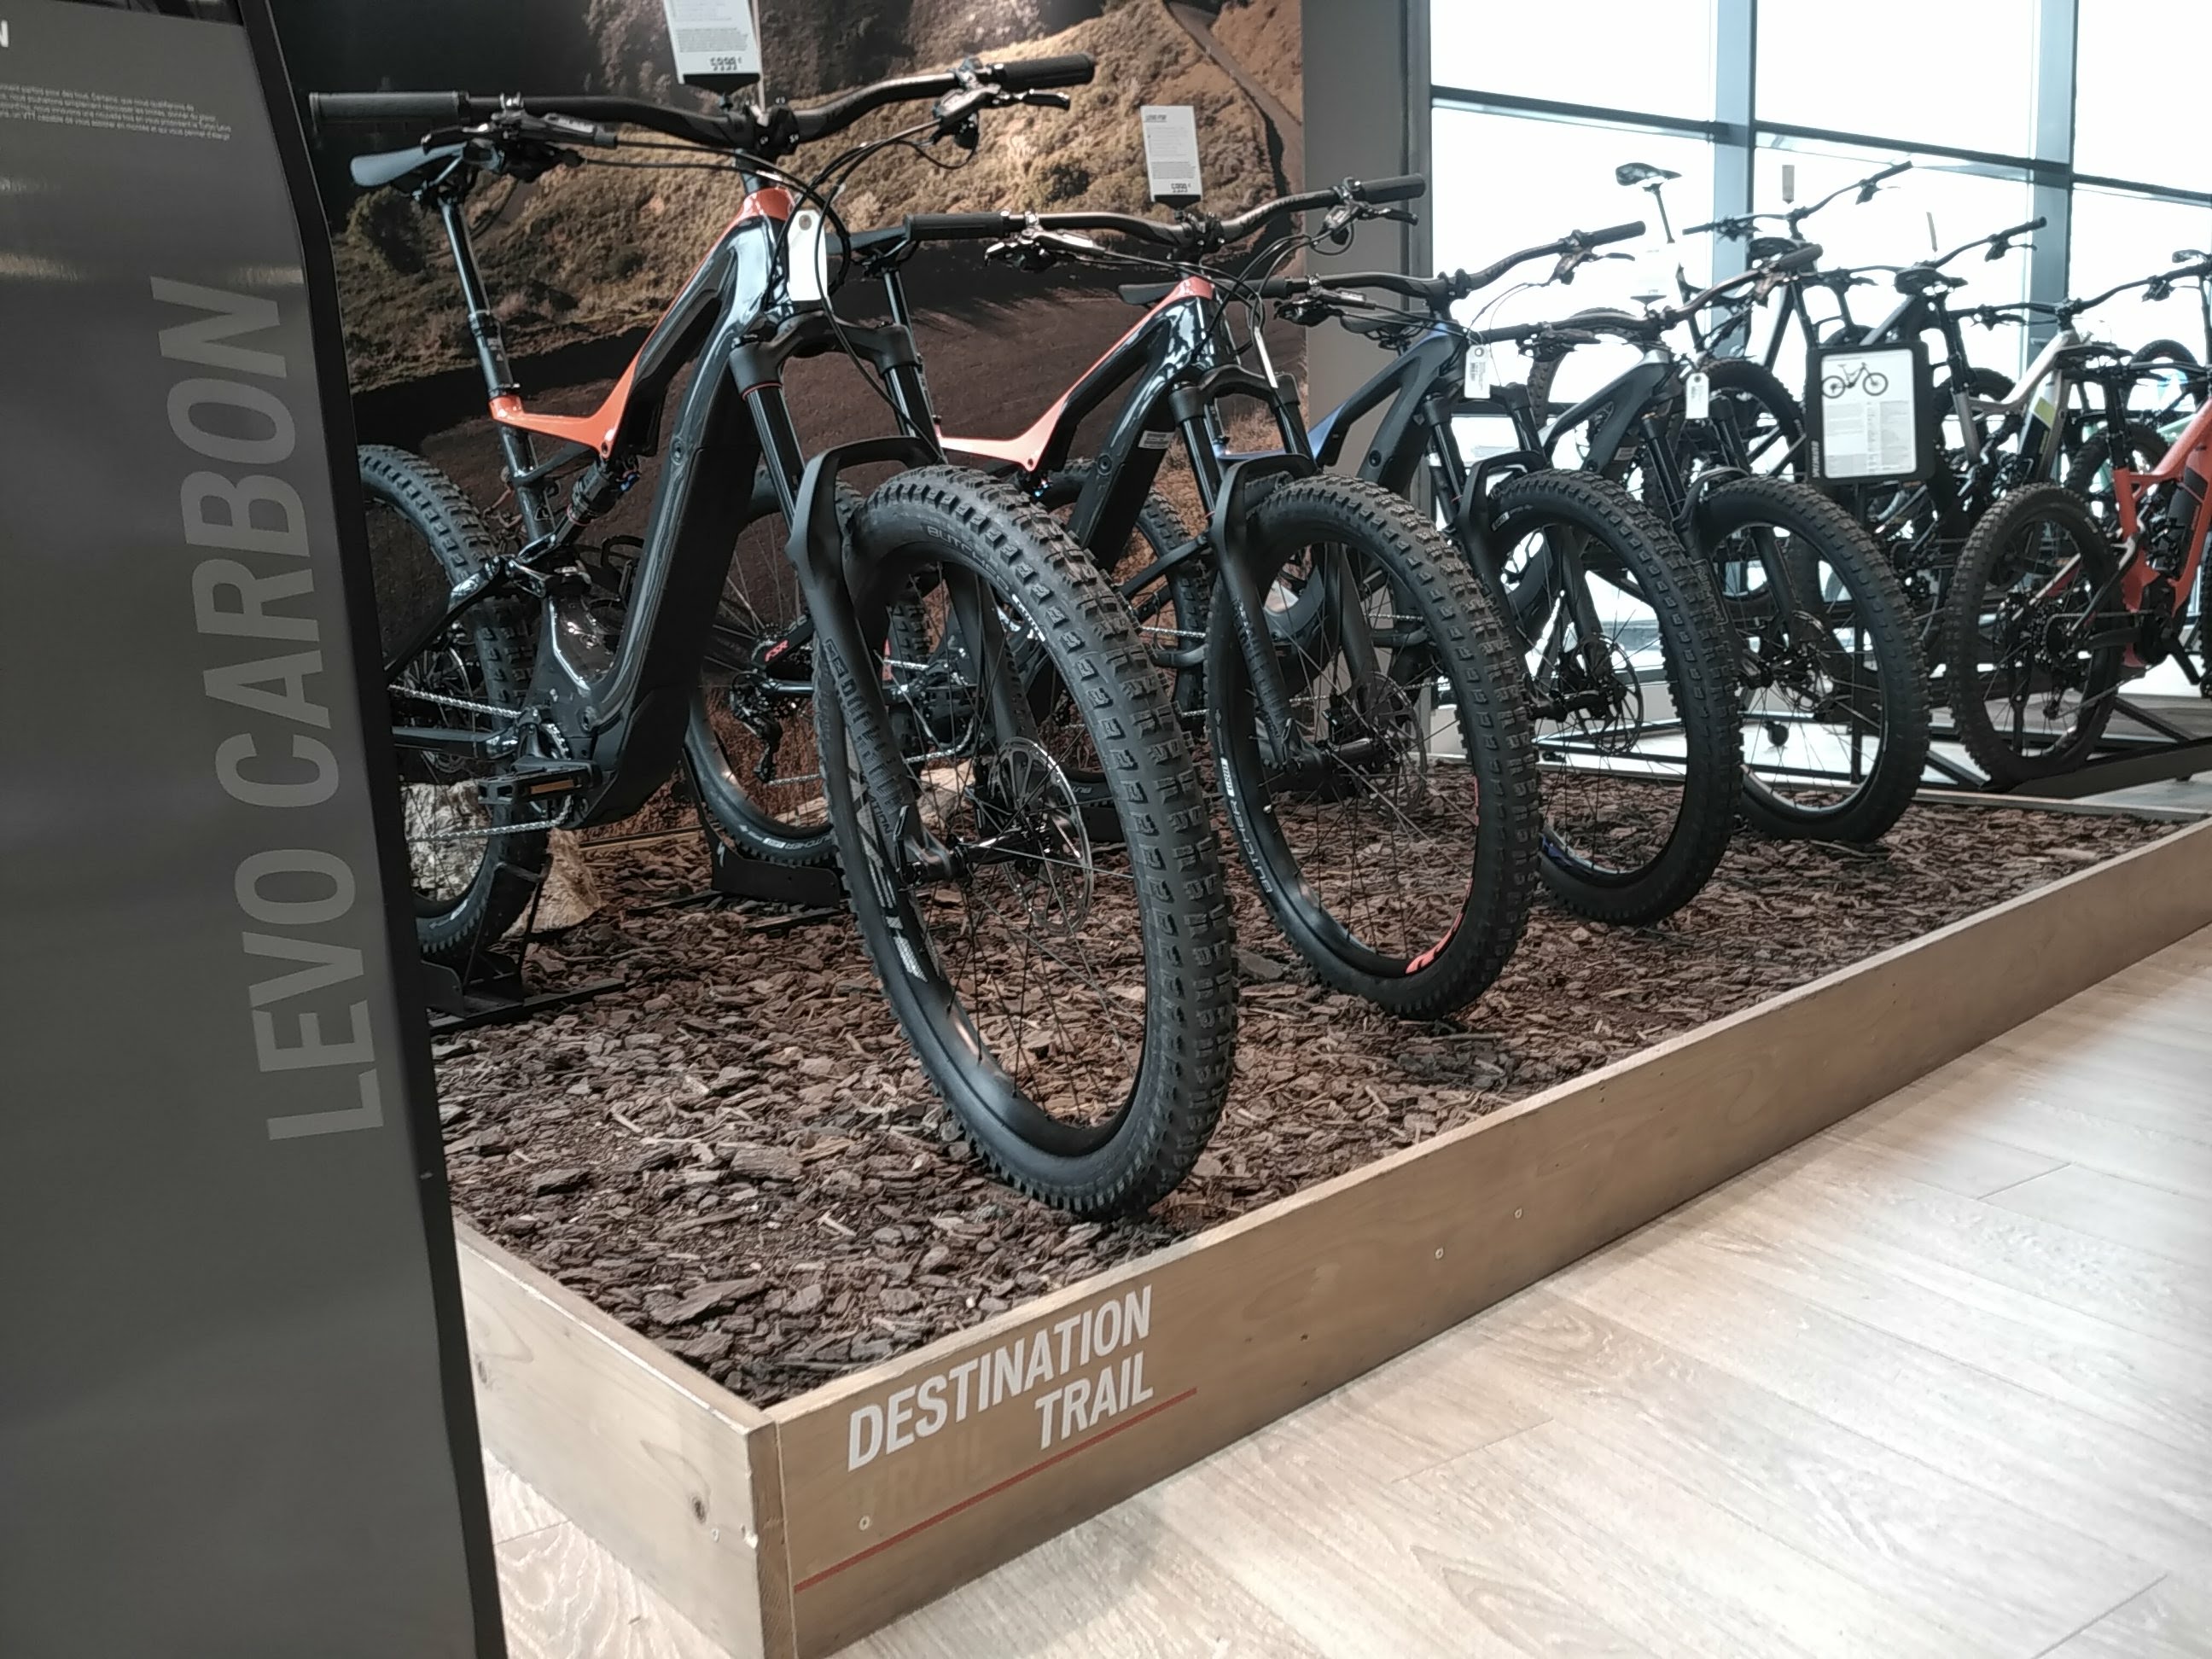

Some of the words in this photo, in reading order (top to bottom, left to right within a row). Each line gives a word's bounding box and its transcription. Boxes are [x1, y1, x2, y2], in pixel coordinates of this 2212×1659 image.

[149, 276, 339, 807] CARBON
[765, 639, 789, 662] FSR
[1230, 800, 1273, 894] BUTCHER
[234, 848, 384, 1140] LEVO
[847, 1284, 1153, 1472] DESTINATION
[1034, 1351, 1154, 1450] TRAIL
